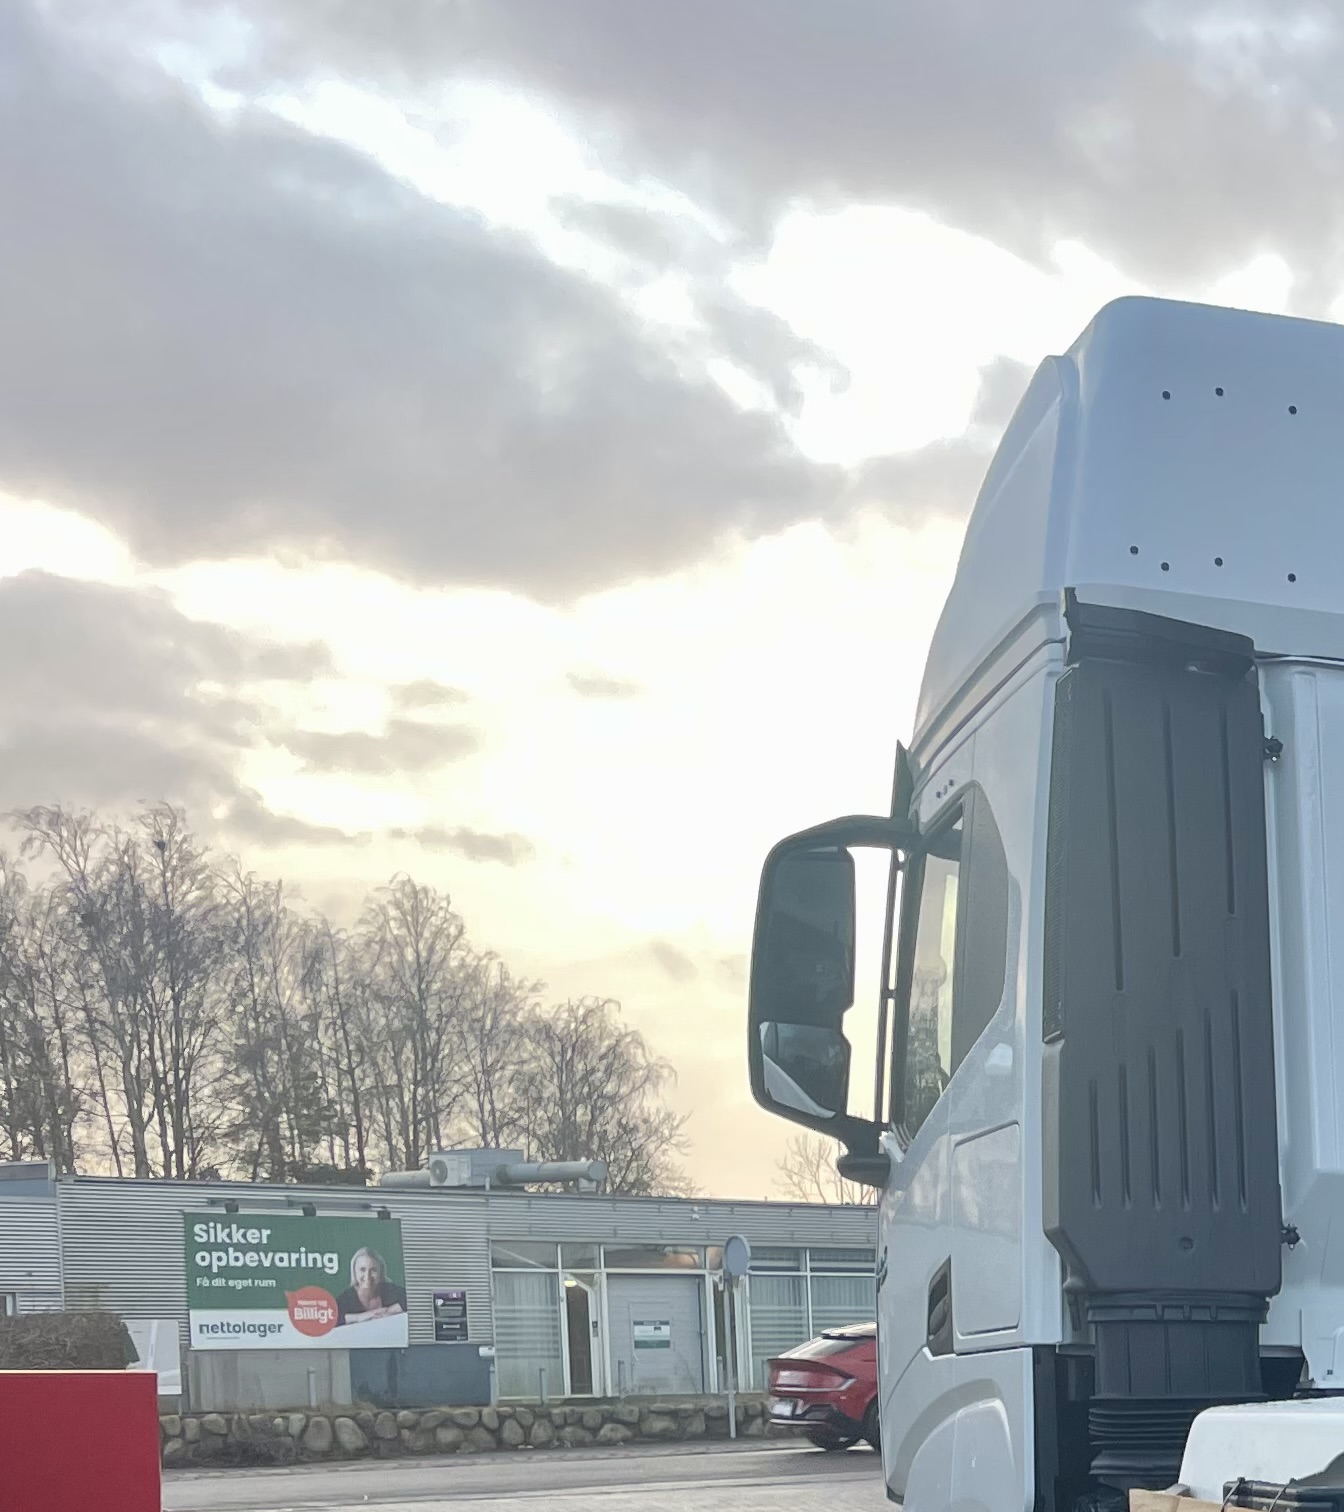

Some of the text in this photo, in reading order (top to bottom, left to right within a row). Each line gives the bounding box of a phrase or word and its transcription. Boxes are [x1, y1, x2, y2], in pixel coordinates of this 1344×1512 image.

[193, 1222, 271, 1244] Sikker
[195, 1247, 339, 1274] opbevaring
[196, 1276, 276, 1289] Få dit eget rum
[294, 1306, 334, 1324] Billigt
[199, 1321, 284, 1338] nettolager
